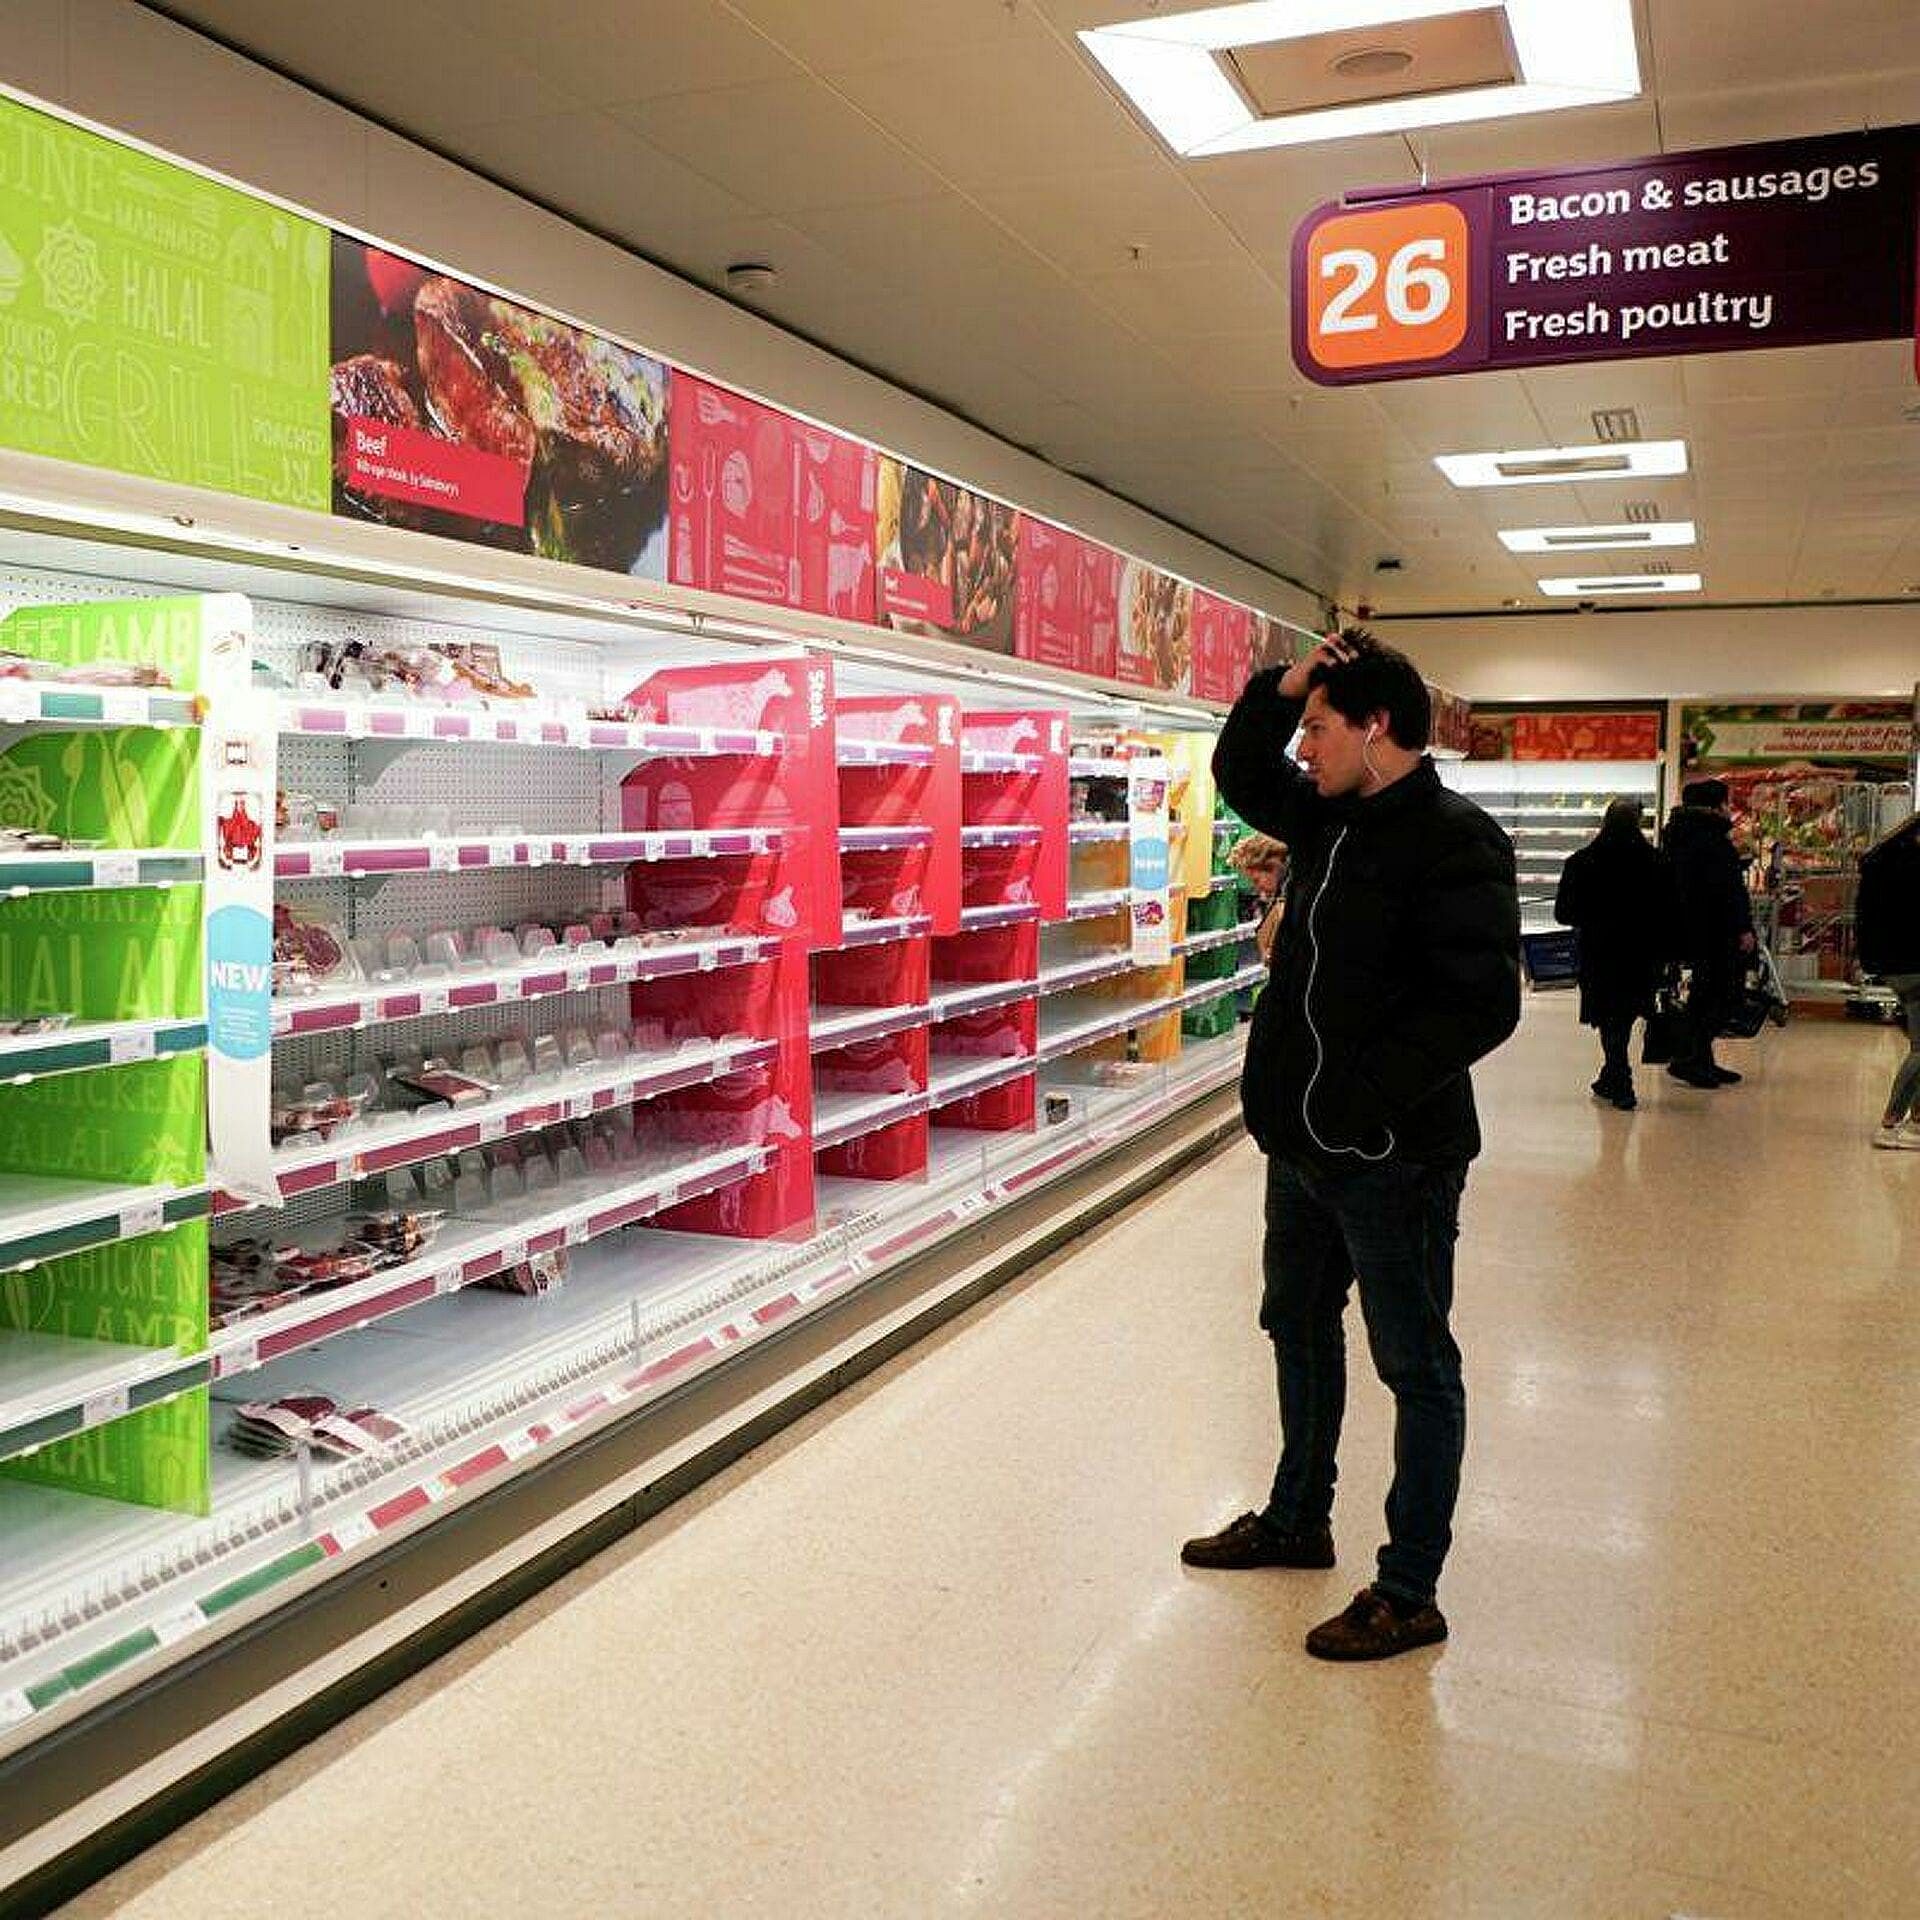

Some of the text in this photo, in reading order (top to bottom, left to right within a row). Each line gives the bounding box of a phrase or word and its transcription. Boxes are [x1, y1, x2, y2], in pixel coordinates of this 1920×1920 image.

[0, 112, 115, 224] INE
[1508, 159, 1880, 226] Bacon & sausages
[1318, 237, 1453, 336] 26
[1507, 231, 1730, 284] Fresh meat
[122, 252, 212, 350] HALAL
[1505, 290, 1773, 342] Fresh poultry
[61, 340, 270, 488] GRILL
[356, 429, 387, 456] Beef
[70, 612, 195, 664] LAMB
[808, 668, 826, 728] Steak
[211, 960, 268, 991] NEW
